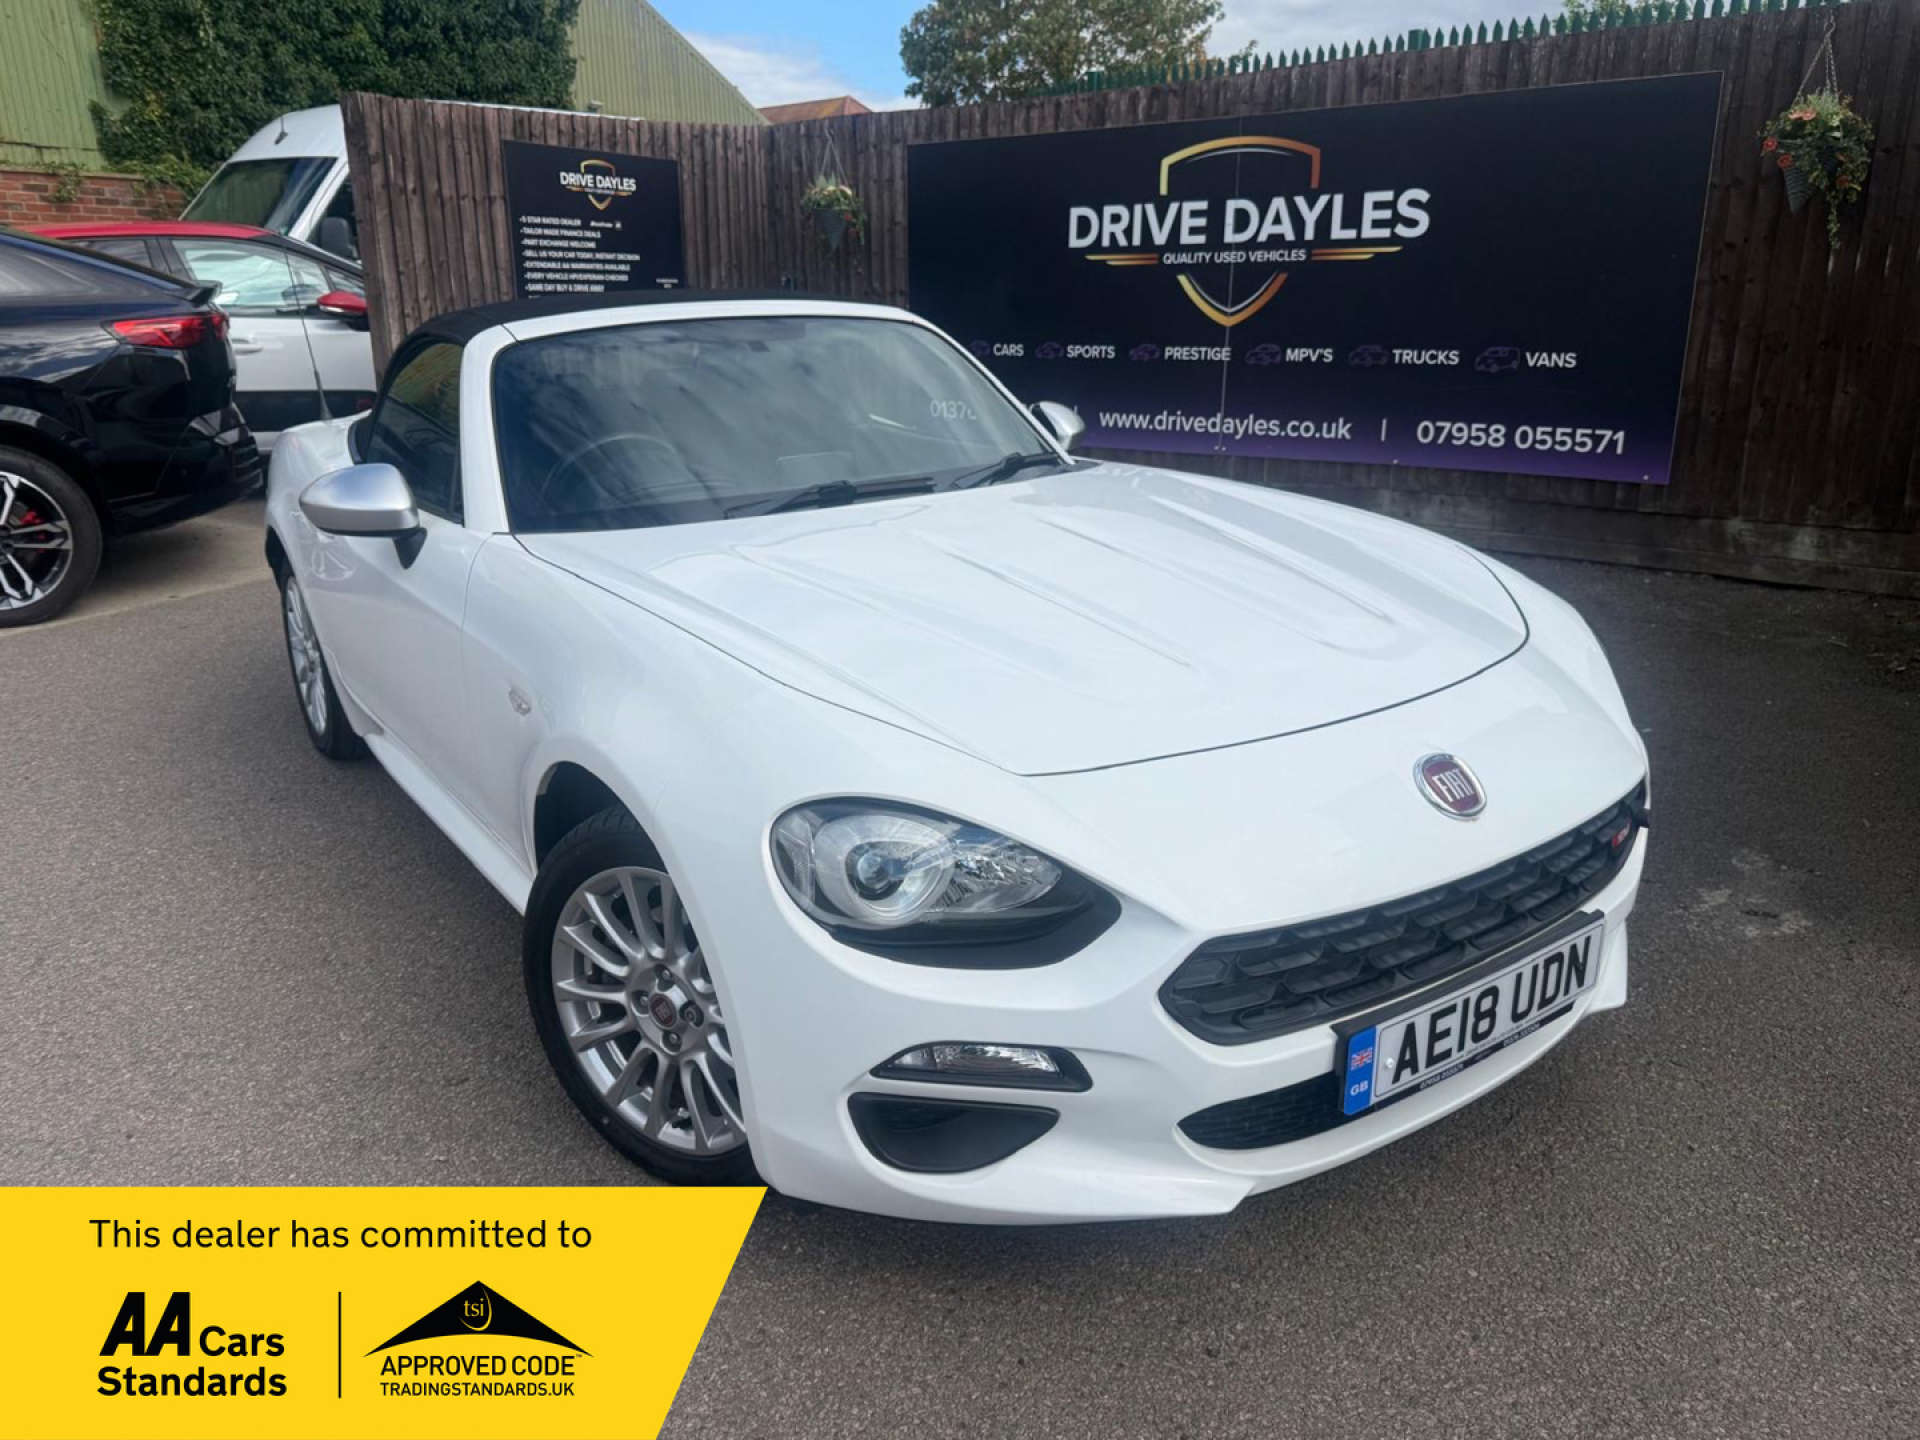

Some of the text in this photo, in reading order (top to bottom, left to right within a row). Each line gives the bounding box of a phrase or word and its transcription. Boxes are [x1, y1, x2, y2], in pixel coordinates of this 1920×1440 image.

[560, 171, 594, 187] DRIVE
[596, 176, 637, 191] DAYLES
[560, 218, 582, 226] DEALER
[1068, 188, 1431, 248] DRIVE DAYLES
[539, 239, 568, 248] EXCHANGE
[569, 241, 596, 249] WELCOME
[1163, 249, 1307, 265] QUALITY USED VEHICLES
[993, 343, 1577, 368] CARS SPORTS PRESTIGE MPV'S TRUCKS VANS
[1099, 410, 1625, 455] www.drivedayles.co.uk 07958 055571
[1431, 768, 1476, 802] FIAT
[1392, 936, 1592, 1085] AE18 UDN
[1350, 1080, 1369, 1096] GB
